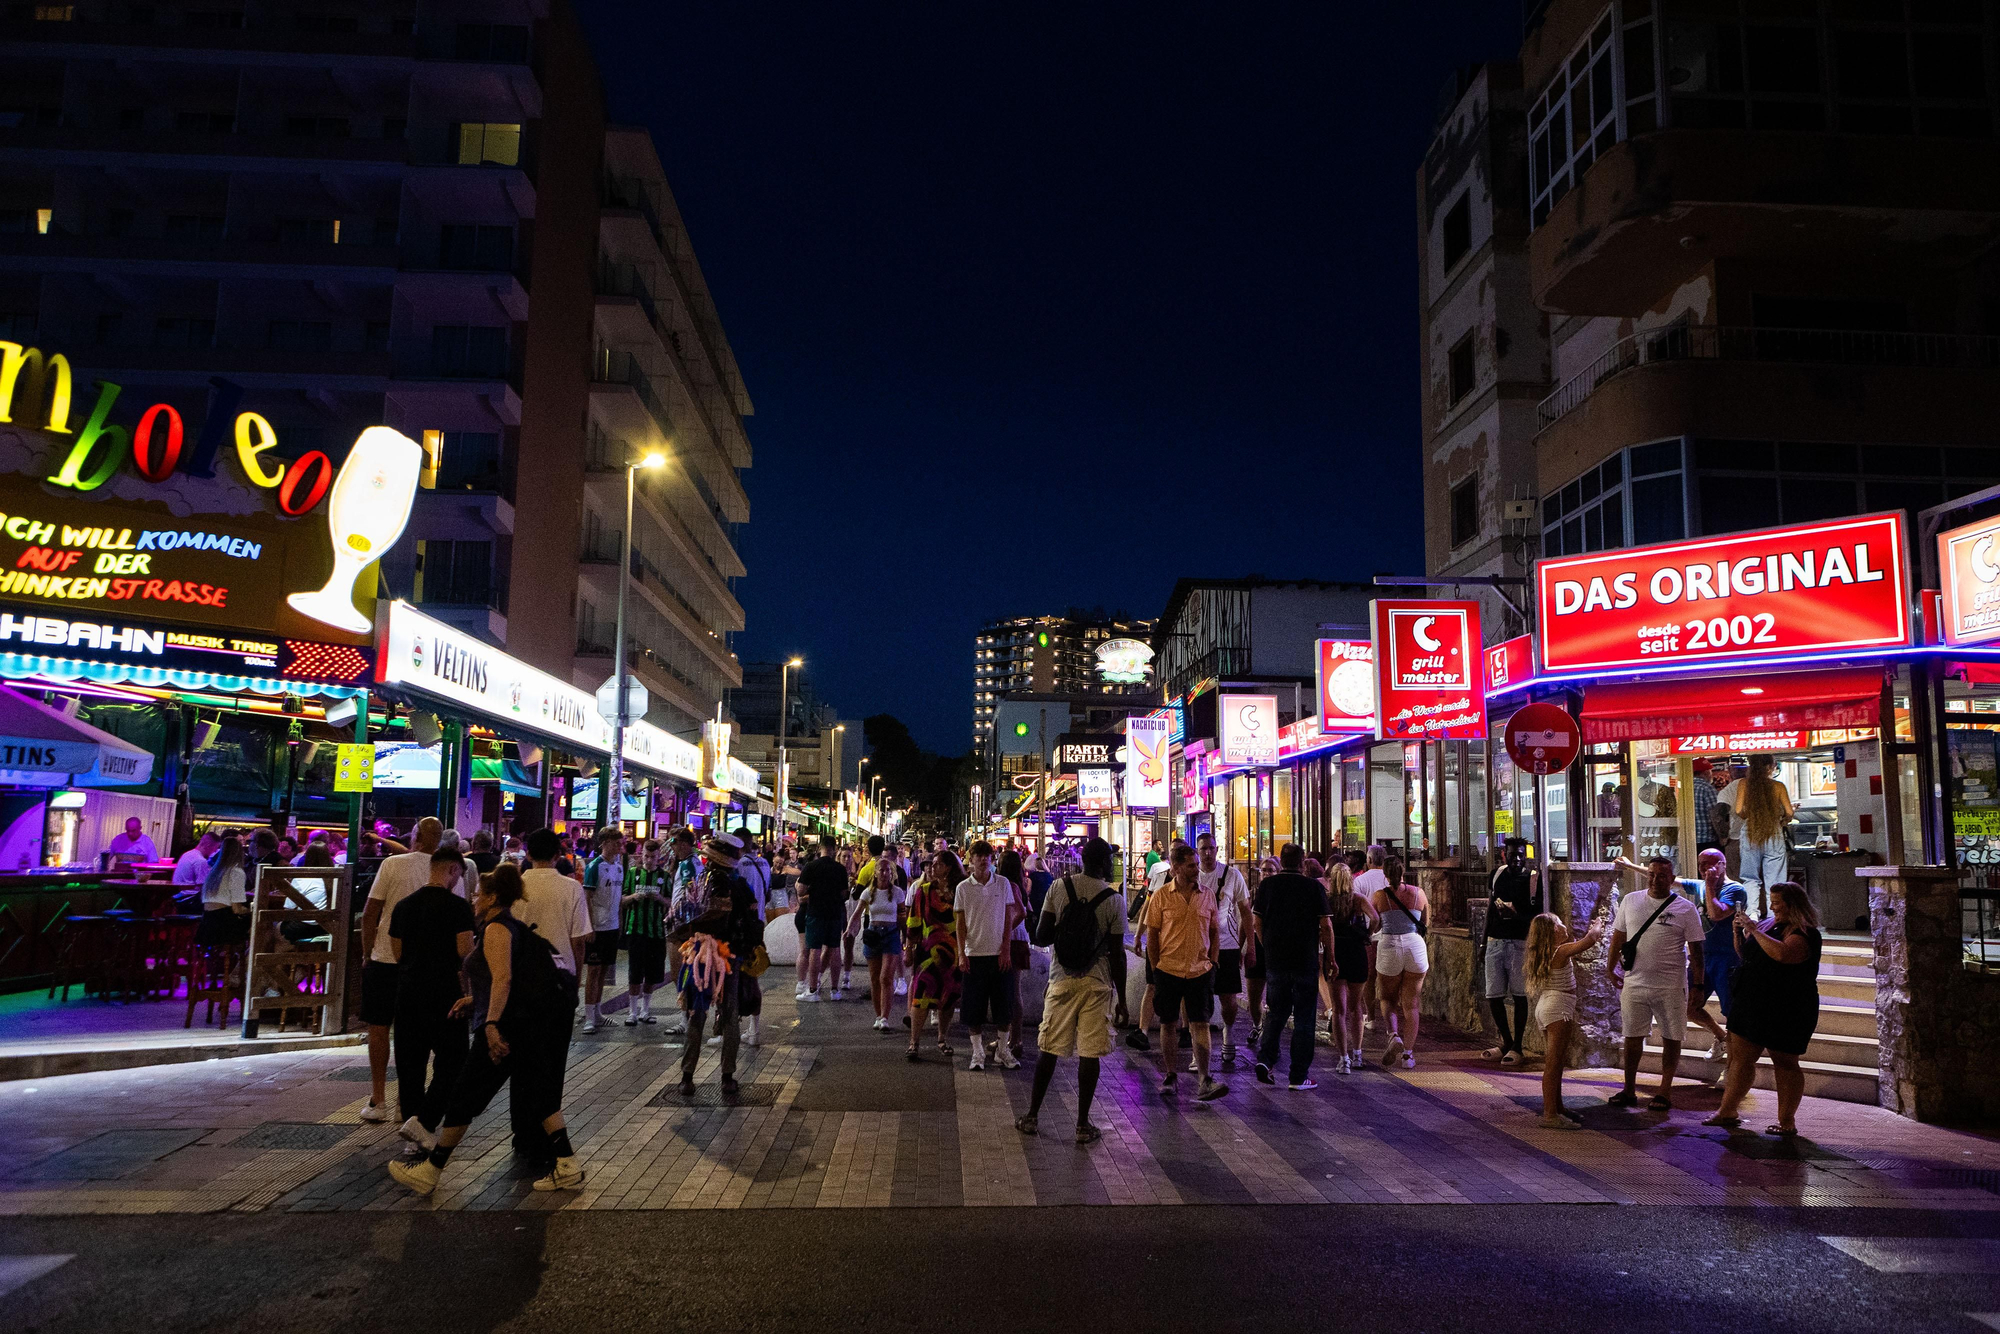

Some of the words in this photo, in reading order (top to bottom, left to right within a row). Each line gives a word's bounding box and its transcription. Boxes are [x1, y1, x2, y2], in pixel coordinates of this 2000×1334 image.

[17, 546, 83, 572] AUF
[94, 552, 152, 575] DER
[1553, 571, 1638, 616] DAS
[1649, 543, 1884, 605] ORIGINAL
[0, 613, 165, 656] HBAHN
[1637, 623, 1681, 639] desde
[1640, 636, 1680, 655] seit
[1685, 612, 1777, 650] 2002
[167, 632, 225, 649] MUSIK
[230, 639, 278, 655] TANZ
[433, 637, 489, 694] VELTINS
[1411, 655, 1445, 671] grill
[1402, 670, 1460, 684] meister
[552, 691, 587, 731] VELTINS
[1412, 704, 1442, 717] Wurst
[1442, 697, 1470, 712] macht
[1131, 719, 1166, 731] NACHTCLUB
[1408, 722, 1425, 734] den
[1424, 712, 1481, 731] Unterschied!
[1066, 744, 1109, 755] PARTY
[1678, 735, 1726, 751] 24h
[1728, 738, 1799, 751] GEÖFFNET
[0, 745, 56, 766] TINS
[1066, 754, 1109, 763] KELLER
[1228, 746, 1273, 758] meister
[108, 754, 138, 776] VELTINS
[1013, 790, 1032, 805] SAN
[1088, 786, 1100, 794] 50
[1965, 824, 1983, 834] ABEND
